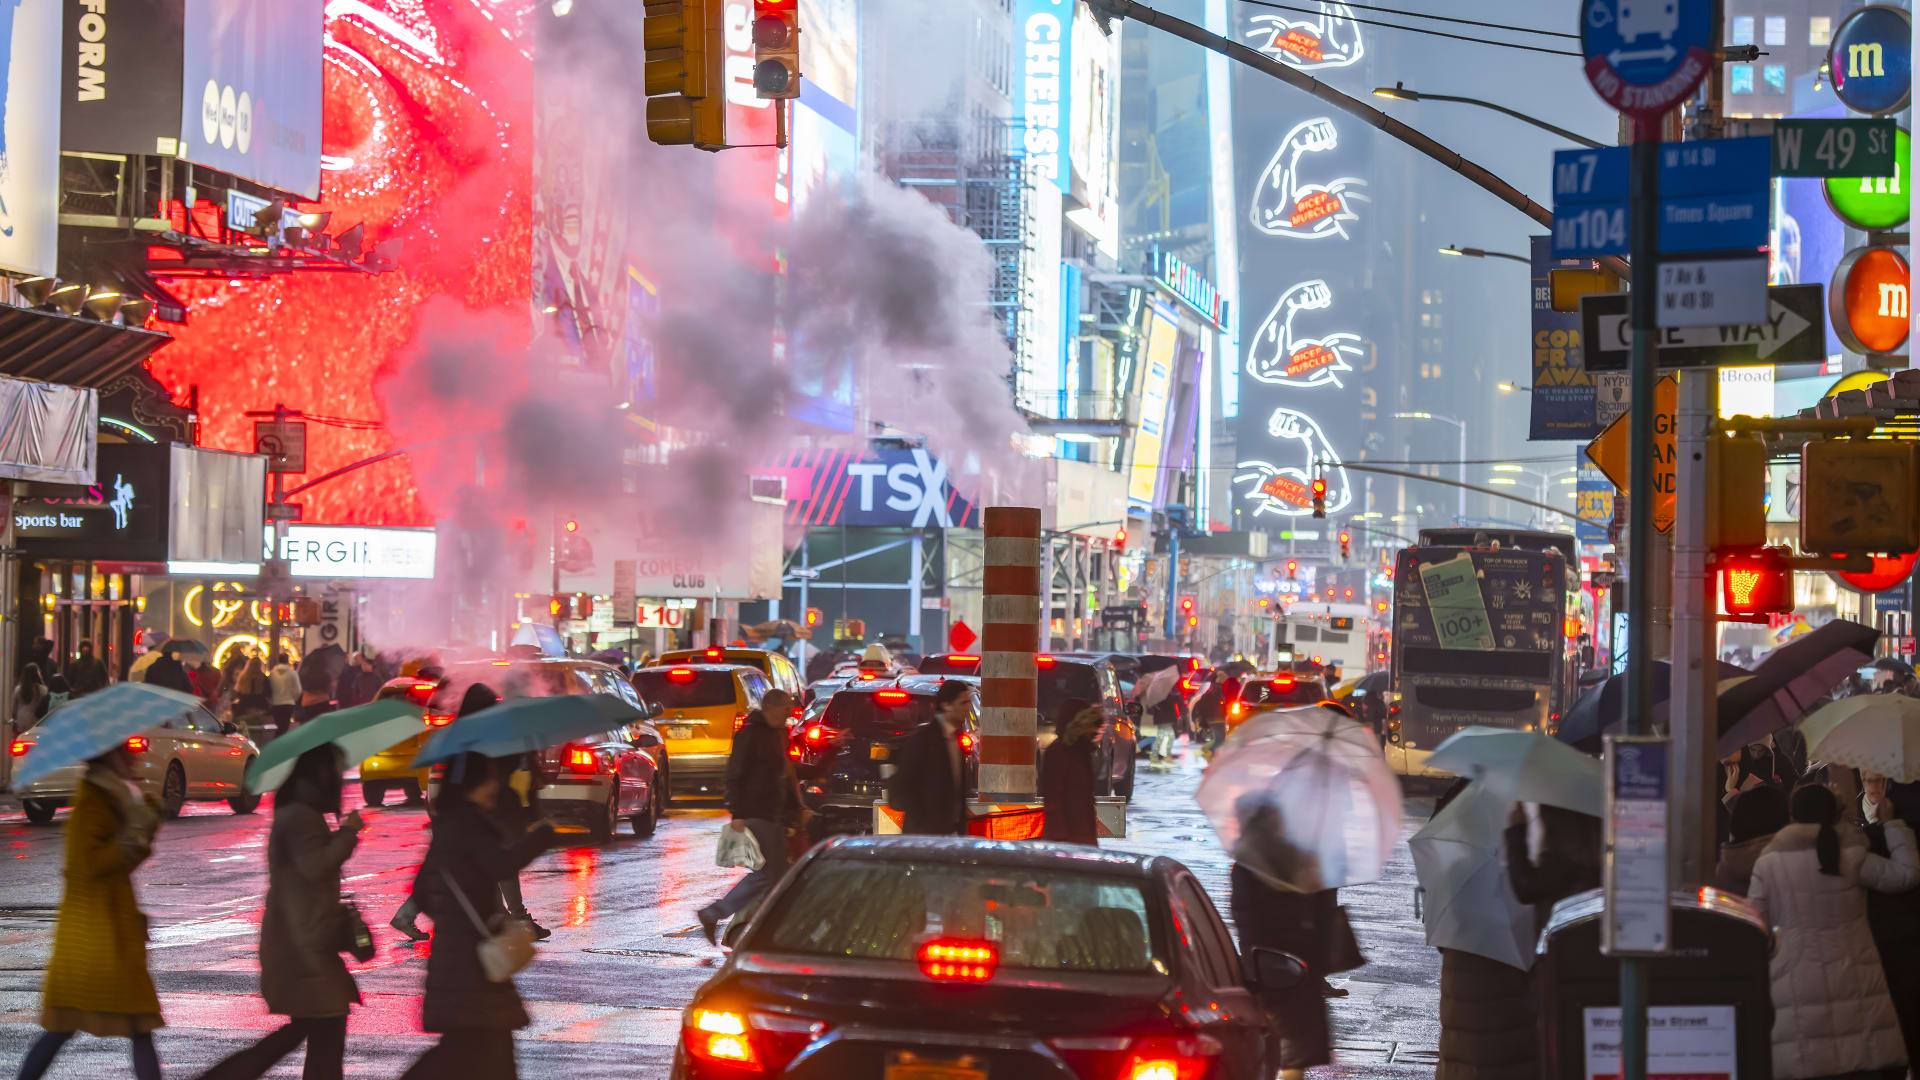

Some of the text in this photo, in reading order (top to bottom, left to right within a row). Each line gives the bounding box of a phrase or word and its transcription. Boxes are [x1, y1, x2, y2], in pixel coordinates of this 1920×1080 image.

[1274, 36, 1324, 62] MUSCLES
[1287, 30, 1320, 49] BICEP
[1848, 43, 1884, 77] m
[1596, 56, 1701, 109] NO STANDING
[1664, 150, 1679, 168] W
[1777, 127, 1888, 170] W 49 St
[1556, 154, 1598, 194] M7
[1290, 197, 1340, 228] MUSCLES
[1296, 192, 1328, 212] BICEP
[1665, 202, 1752, 223] Times Square
[1556, 208, 1626, 249] M104
[1878, 283, 1907, 318] m
[1286, 351, 1335, 376] MUSCLES
[1291, 346, 1323, 364] BICEP
[1535, 368, 1597, 386] AWA
[848, 448, 954, 528] TSX
[1262, 483, 1311, 508] MUSCLES
[1274, 477, 1307, 495] BICEP
[60, 513, 84, 528] bar
[673, 573, 705, 588] CLUB
[1440, 614, 1484, 639] 100+
[1536, 639, 1554, 649] 191
